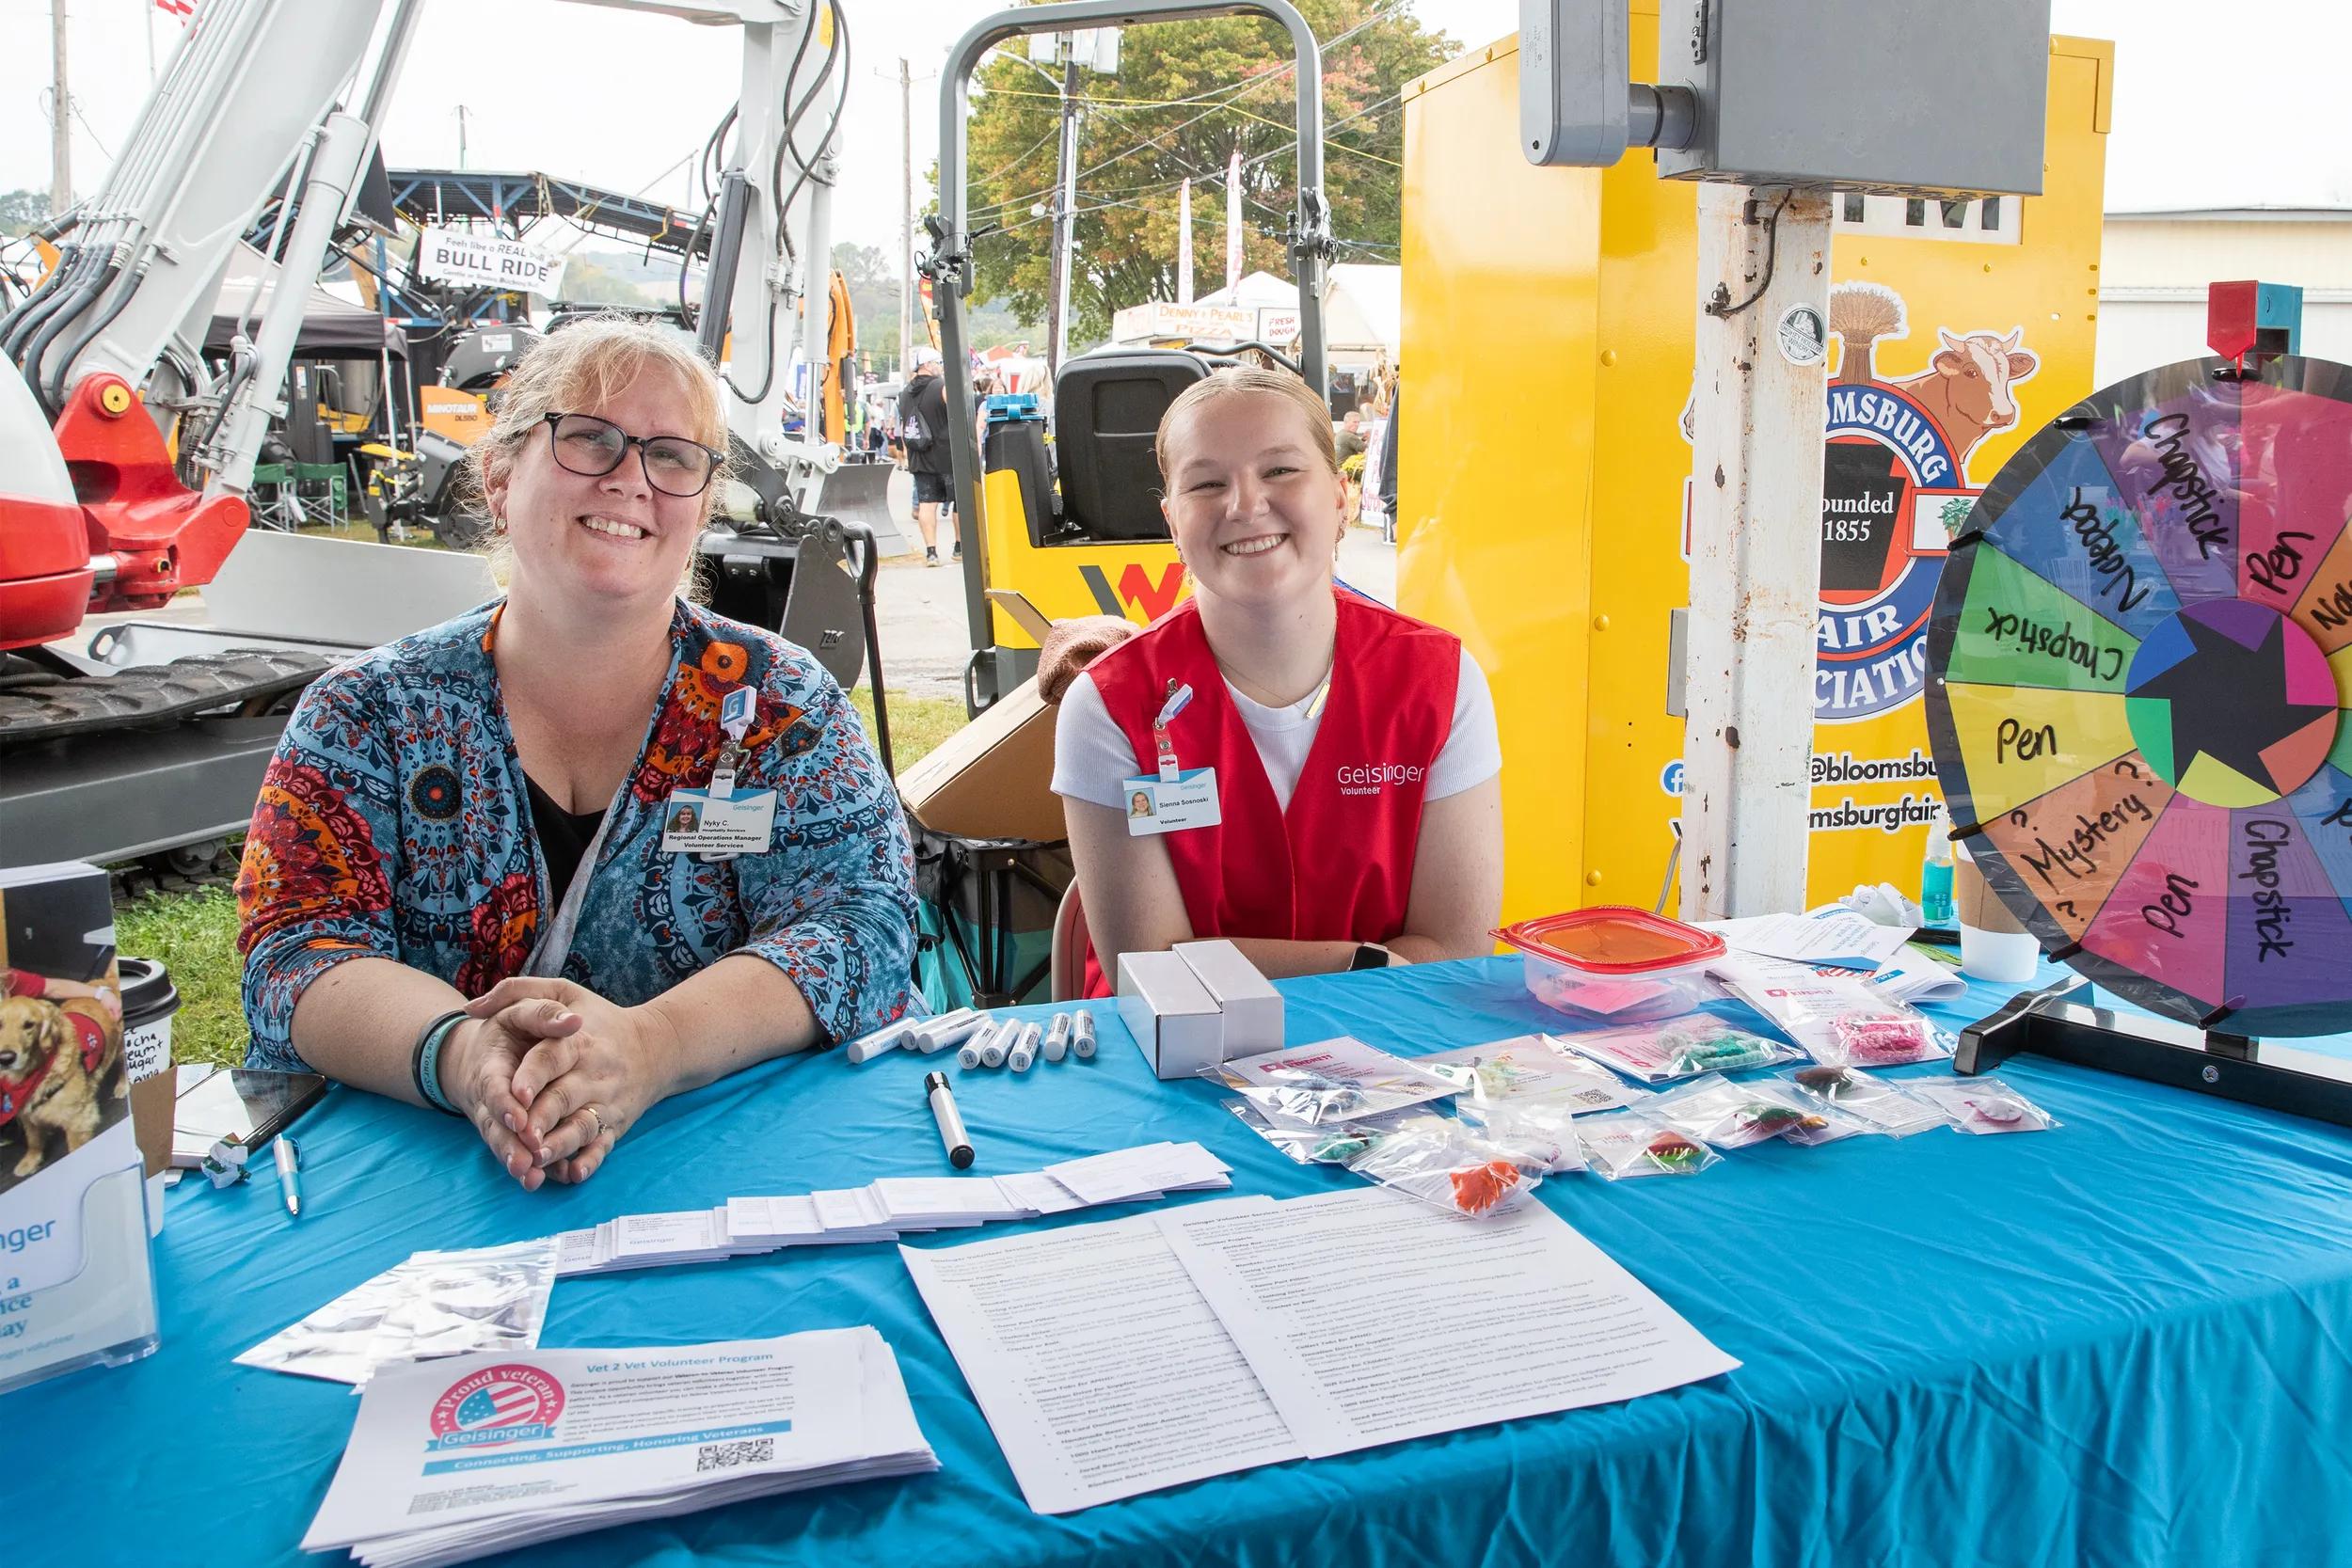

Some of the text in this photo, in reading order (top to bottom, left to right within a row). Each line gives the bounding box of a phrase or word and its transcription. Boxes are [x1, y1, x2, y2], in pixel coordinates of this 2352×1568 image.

[498, 244, 526, 257] REAL
[436, 248, 548, 282] BULL RIDE
[1159, 305, 1199, 319] DENNY
[1210, 309, 1253, 322] PEARL'S
[1269, 317, 1295, 326] FRESH
[1176, 325, 1233, 337] PIZZA
[427, 404, 477, 414] MINOTAUR
[1826, 391, 1947, 483] MSBURG
[2144, 413, 2229, 560] Chapstick
[1824, 519, 1871, 541] 1855
[2246, 531, 2315, 595] Pen
[1985, 607, 2122, 682] Chapstick
[1997, 718, 2058, 764] Pen
[1338, 762, 1425, 785] Geisinger
[1341, 786, 1381, 796] Volunteer
[733, 803, 765, 812] Geisinger
[1159, 800, 1181, 809] Sienna
[1160, 816, 1187, 825] Volunteer
[2020, 792, 2152, 895] Mystery
[2237, 819, 2295, 962] Chapstick
[2141, 873, 2199, 939] Pen
[586, 1353, 774, 1373] Vet 2 Vet Volunteer Program
[441, 1370, 556, 1408] Proud veteran
[445, 1425, 541, 1446] Geisinger
[633, 1433, 699, 1449] Honoring
[702, 1426, 765, 1441] Veterans
